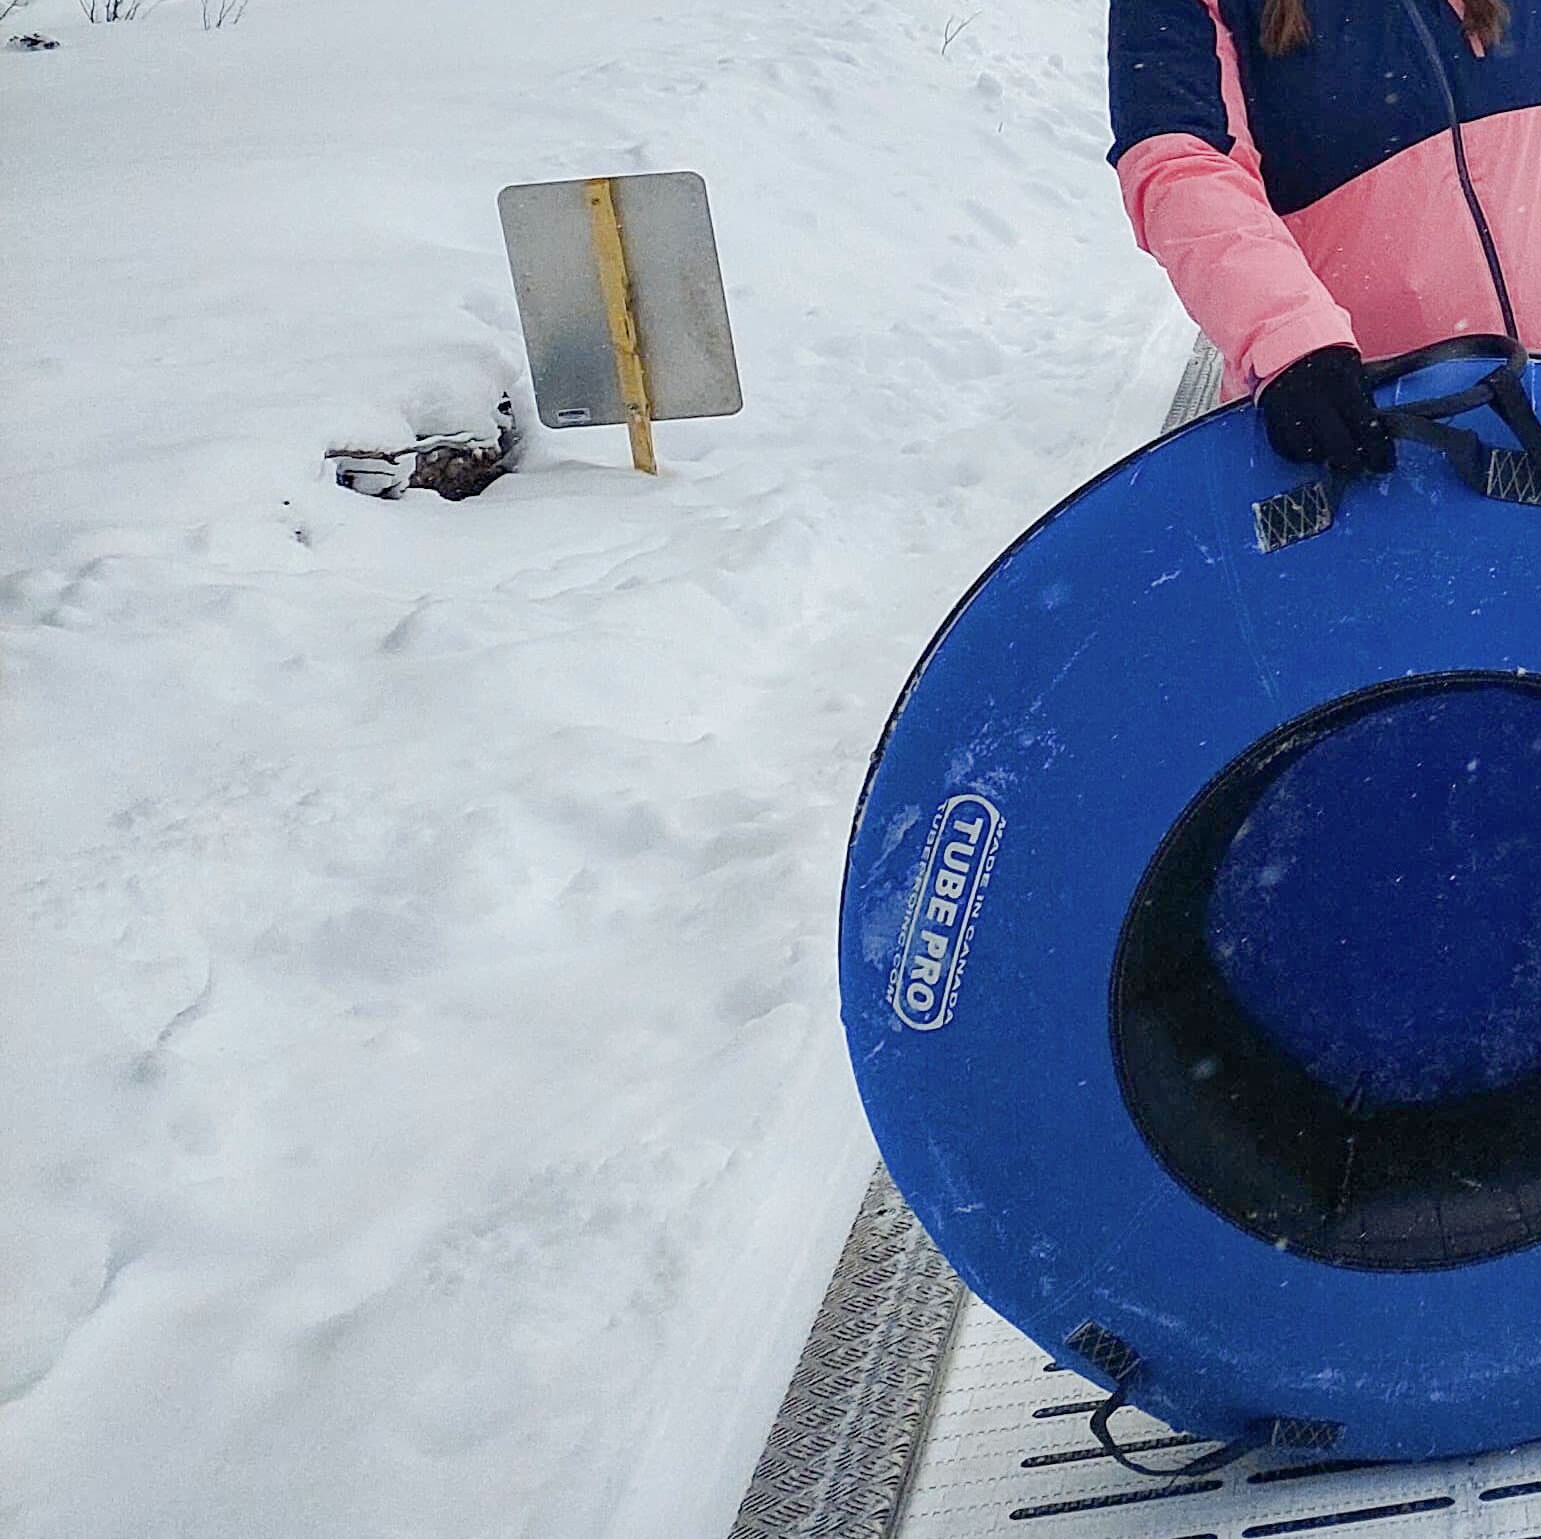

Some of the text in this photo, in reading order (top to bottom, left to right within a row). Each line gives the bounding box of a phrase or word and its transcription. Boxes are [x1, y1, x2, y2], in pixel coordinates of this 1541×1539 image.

[906, 817, 984, 1012] TUBE PRO
[943, 816, 1007, 1025] MADE IN CANADA
